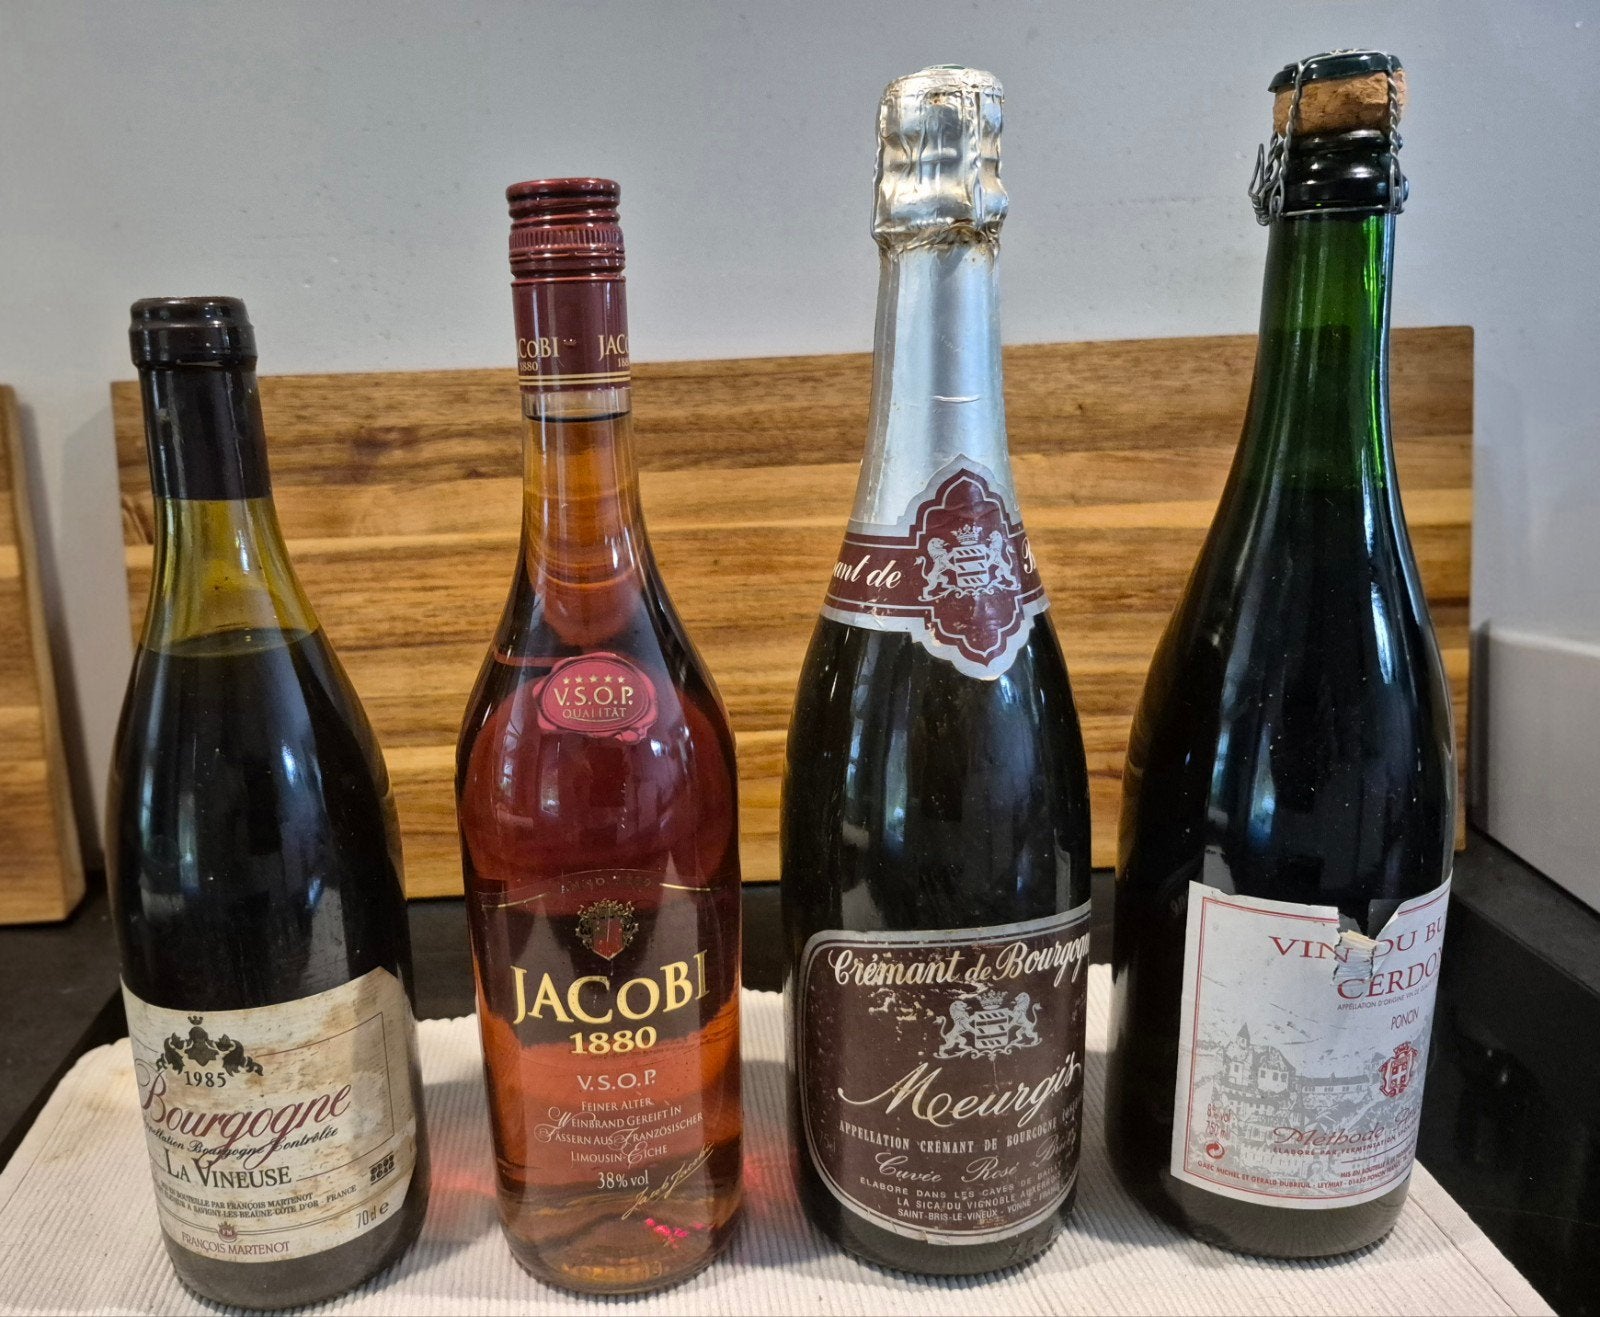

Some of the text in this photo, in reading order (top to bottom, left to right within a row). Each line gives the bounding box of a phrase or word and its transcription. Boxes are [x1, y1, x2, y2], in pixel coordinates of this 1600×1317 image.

[866, 559, 902, 589] de
[1268, 935, 1354, 964] VIN
[828, 948, 962, 986] Crémant
[964, 953, 992, 982] de
[1337, 946, 1443, 1000] CERDO
[510, 948, 711, 1026] JACOBI
[570, 1026, 657, 1055] 1880
[184, 1070, 227, 1088] 1985
[134, 1057, 352, 1171] Bourgogne
[548, 1104, 682, 1129] WEINBRAND GEREIFT IN
[581, 1097, 655, 1112] FEINER ALTER
[593, 1136, 614, 1146] AUS
[840, 1119, 910, 1151] APPELLATION
[984, 1137, 998, 1152] DE
[164, 1147, 292, 1189] LA VINEUSE
[597, 1169, 649, 1189] 38% vol
[211, 1200, 225, 1210] PAR
[267, 1192, 313, 1208] MARTENOT
[299, 1199, 320, 1212] D'OR
[325, 1184, 358, 1204] FRANCE
[897, 1197, 910, 1208] LA
[915, 1200, 941, 1211] SICA
[946, 1201, 961, 1211] DU
[966, 1193, 1016, 1210] VIGNOBLE
[916, 1188, 947, 1200] DANS
[954, 1190, 975, 1201] LES
[982, 1183, 1015, 1197] CAVES
[1020, 1177, 1032, 1188] DE
[181, 1231, 290, 1256] FRANÇOIS MARTENOT
